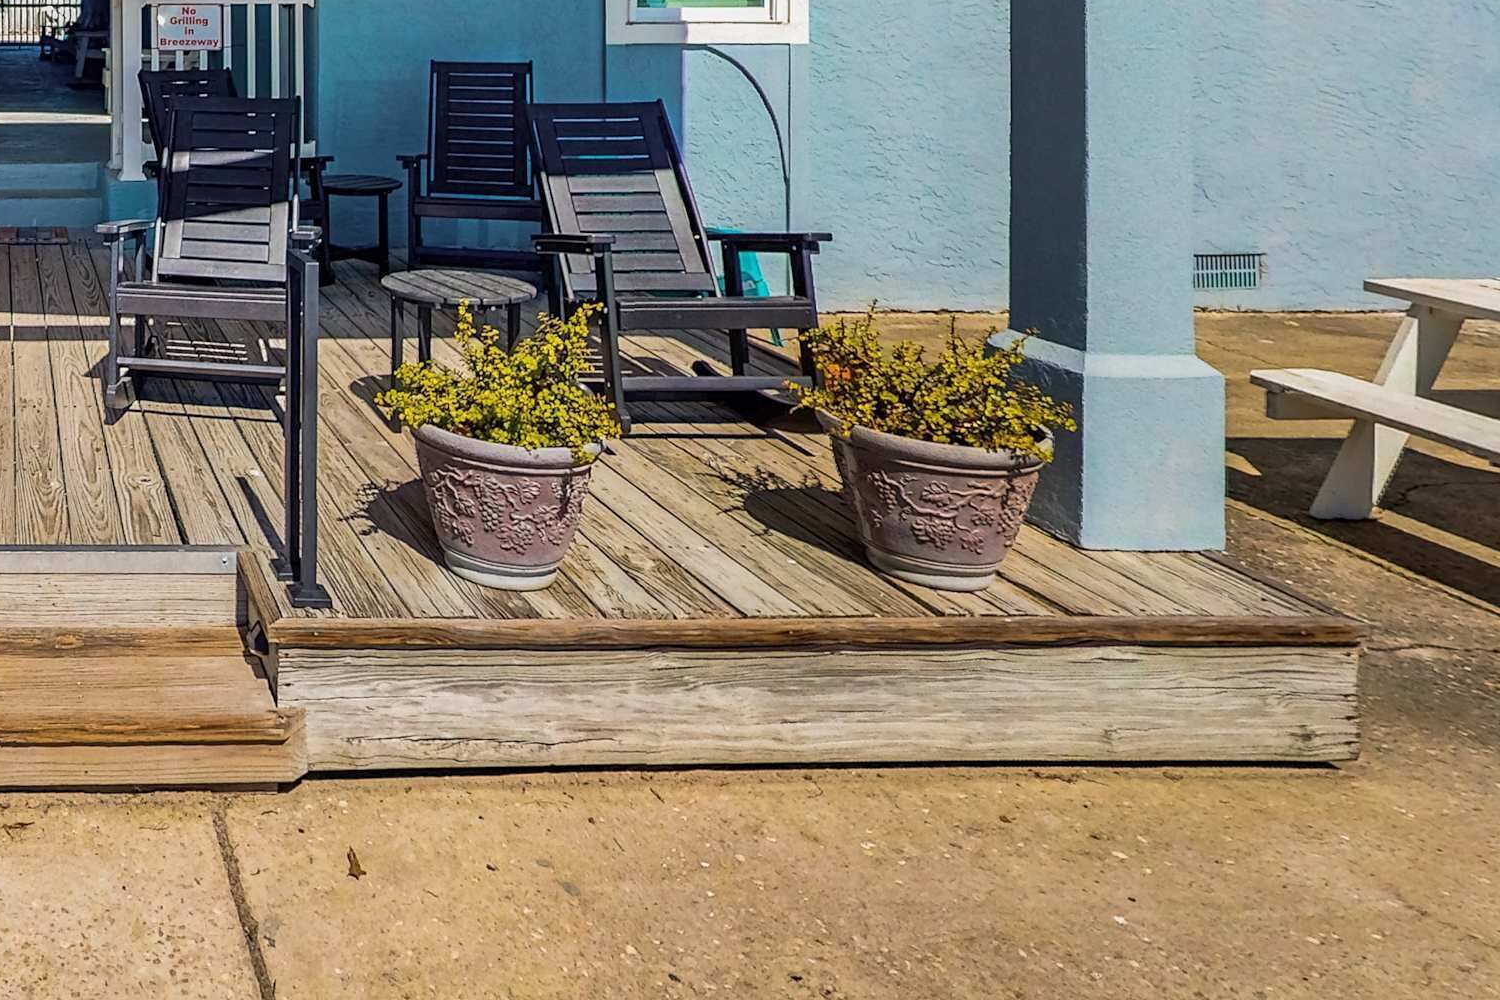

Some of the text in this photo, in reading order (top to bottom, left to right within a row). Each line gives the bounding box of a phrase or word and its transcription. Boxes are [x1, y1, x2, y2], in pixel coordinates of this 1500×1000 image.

[181, 7, 197, 15] No
[170, 16, 209, 26] Grilling
[160, 38, 219, 47] Breezeway
